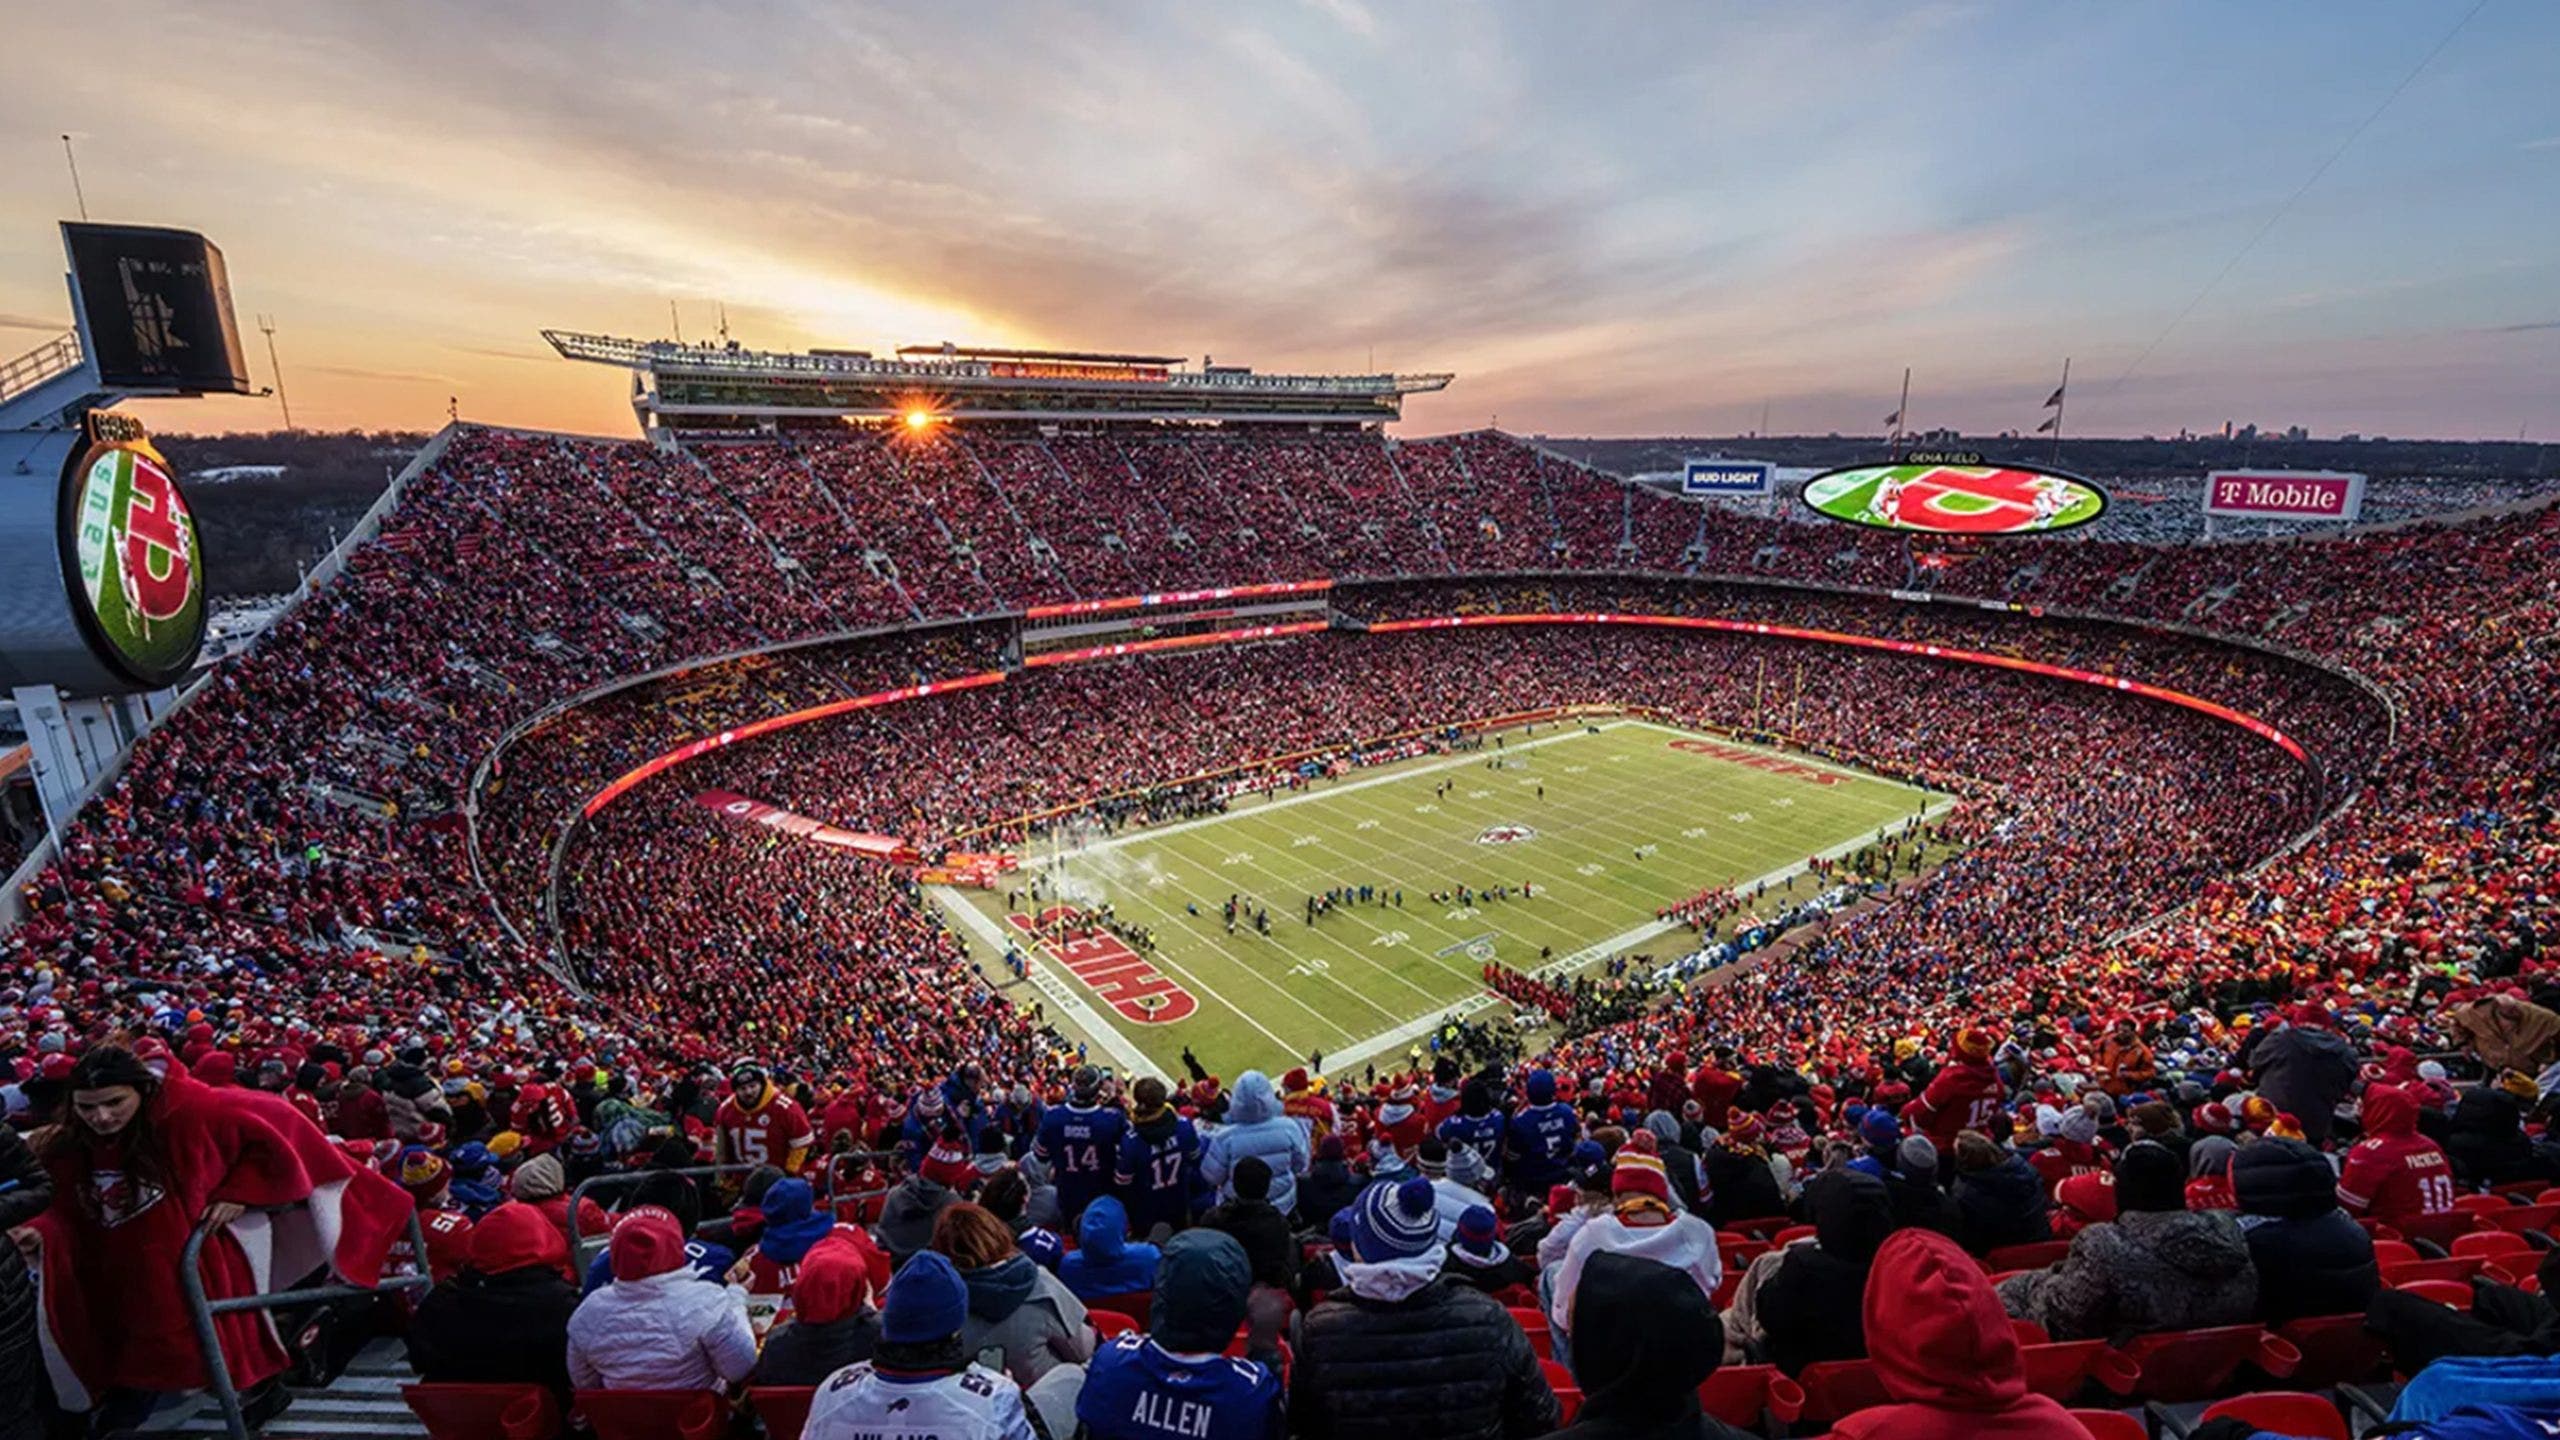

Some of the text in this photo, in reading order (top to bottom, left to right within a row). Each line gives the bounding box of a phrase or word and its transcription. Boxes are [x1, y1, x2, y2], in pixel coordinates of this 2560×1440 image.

[1693, 472, 1760, 484] BUD LIGHT
[2219, 481, 2337, 509] T Mobile
[1966, 1098, 1996, 1128] 15
[729, 1127, 769, 1165] 15
[1063, 1144, 1100, 1172] 14
[1151, 1152, 1182, 1190] 17
[2418, 1174, 2454, 1215] 10
[1034, 1228, 1057, 1252] 17
[1132, 1390, 1212, 1439] ALLEN
